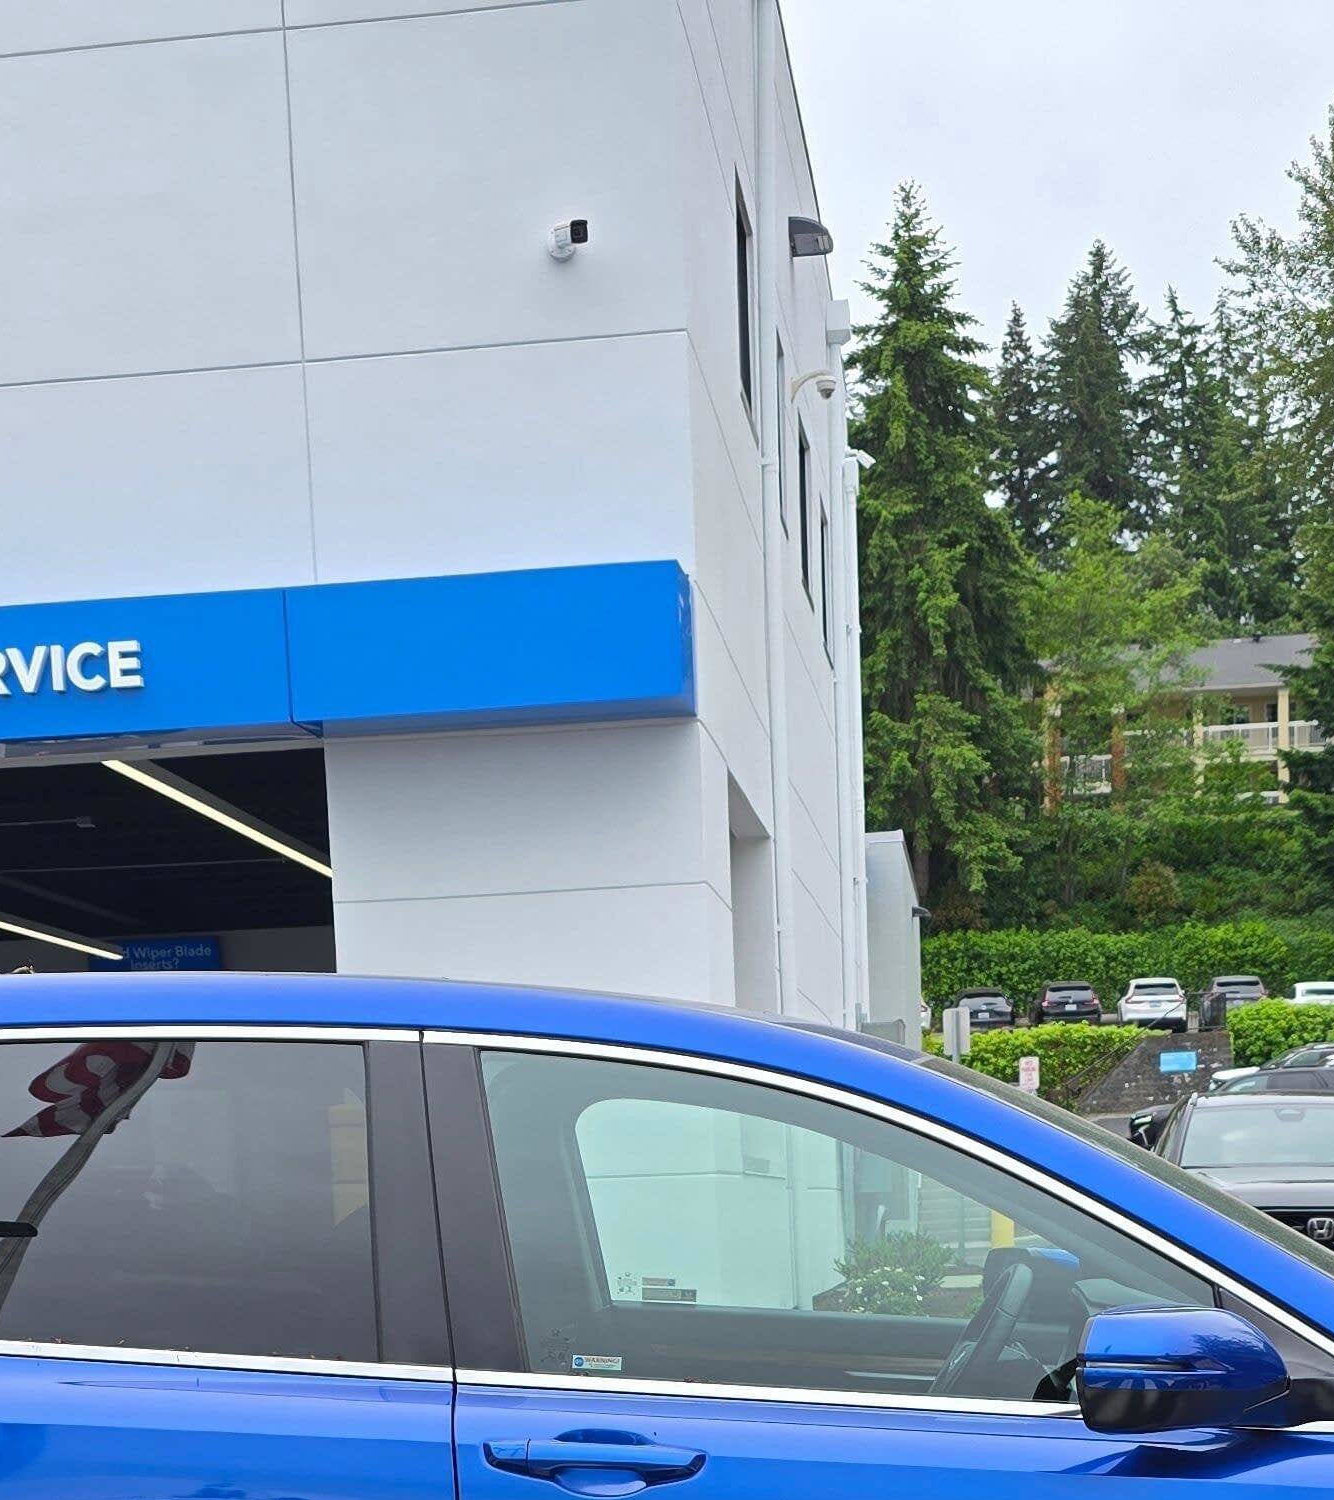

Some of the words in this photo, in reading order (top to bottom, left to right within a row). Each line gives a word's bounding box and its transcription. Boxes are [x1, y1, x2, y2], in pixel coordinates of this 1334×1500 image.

[133, 946, 172, 960] Wiper
[175, 944, 211, 957] Blade
[131, 957, 180, 969] Inserts?
